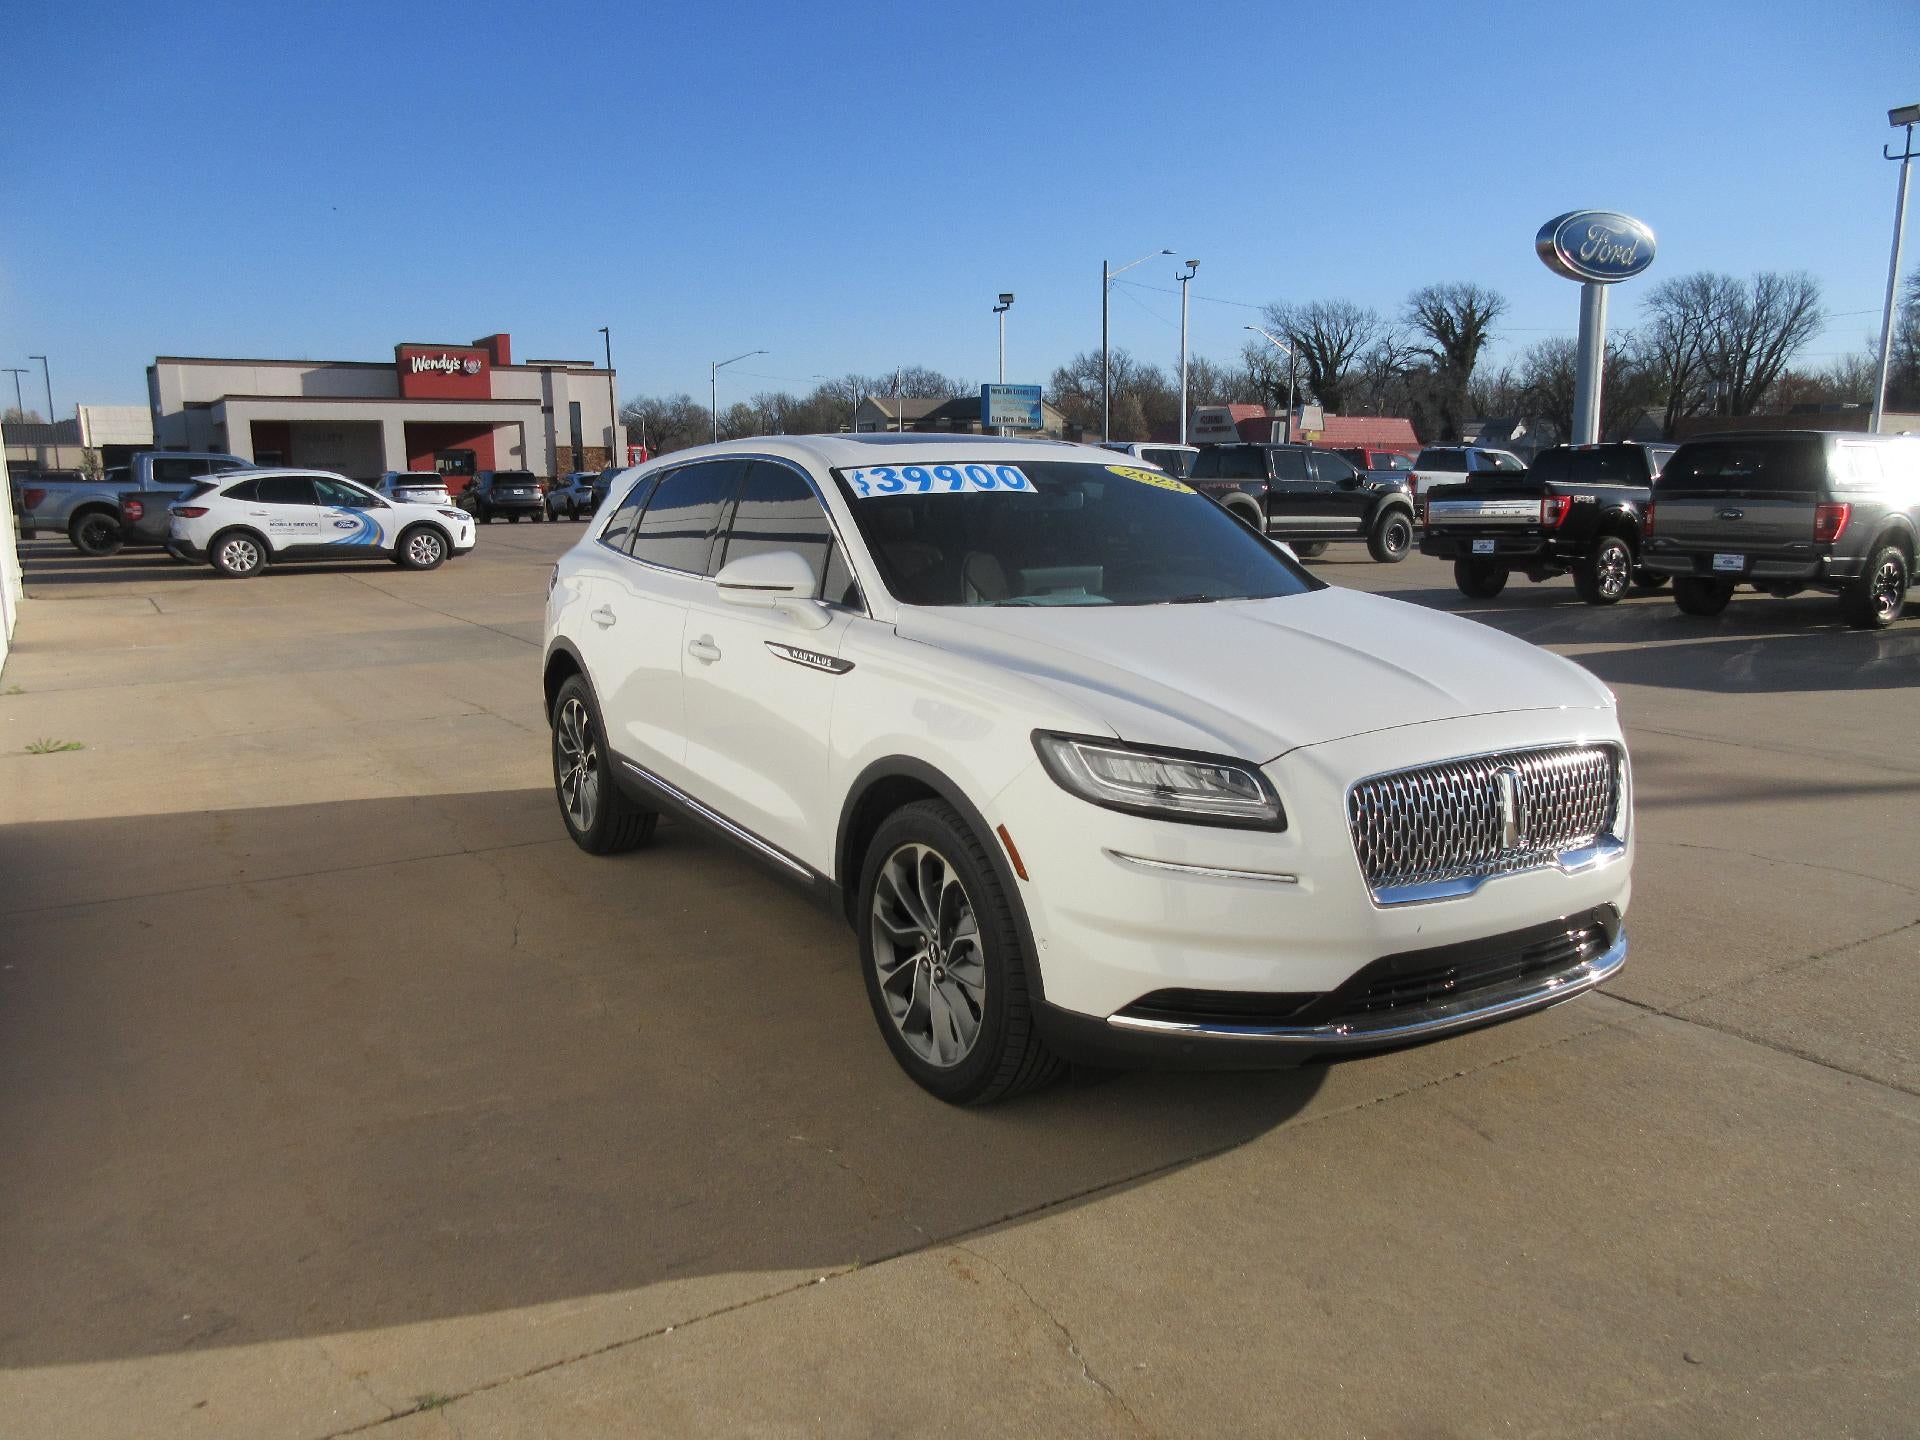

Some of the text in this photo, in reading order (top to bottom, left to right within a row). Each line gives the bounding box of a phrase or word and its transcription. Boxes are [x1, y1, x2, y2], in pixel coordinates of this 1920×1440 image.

[1580, 224, 1638, 266] Ford
[411, 353, 461, 374] Wendy's
[853, 464, 1030, 496] $39900
[792, 649, 832, 667] NAUTILUS
